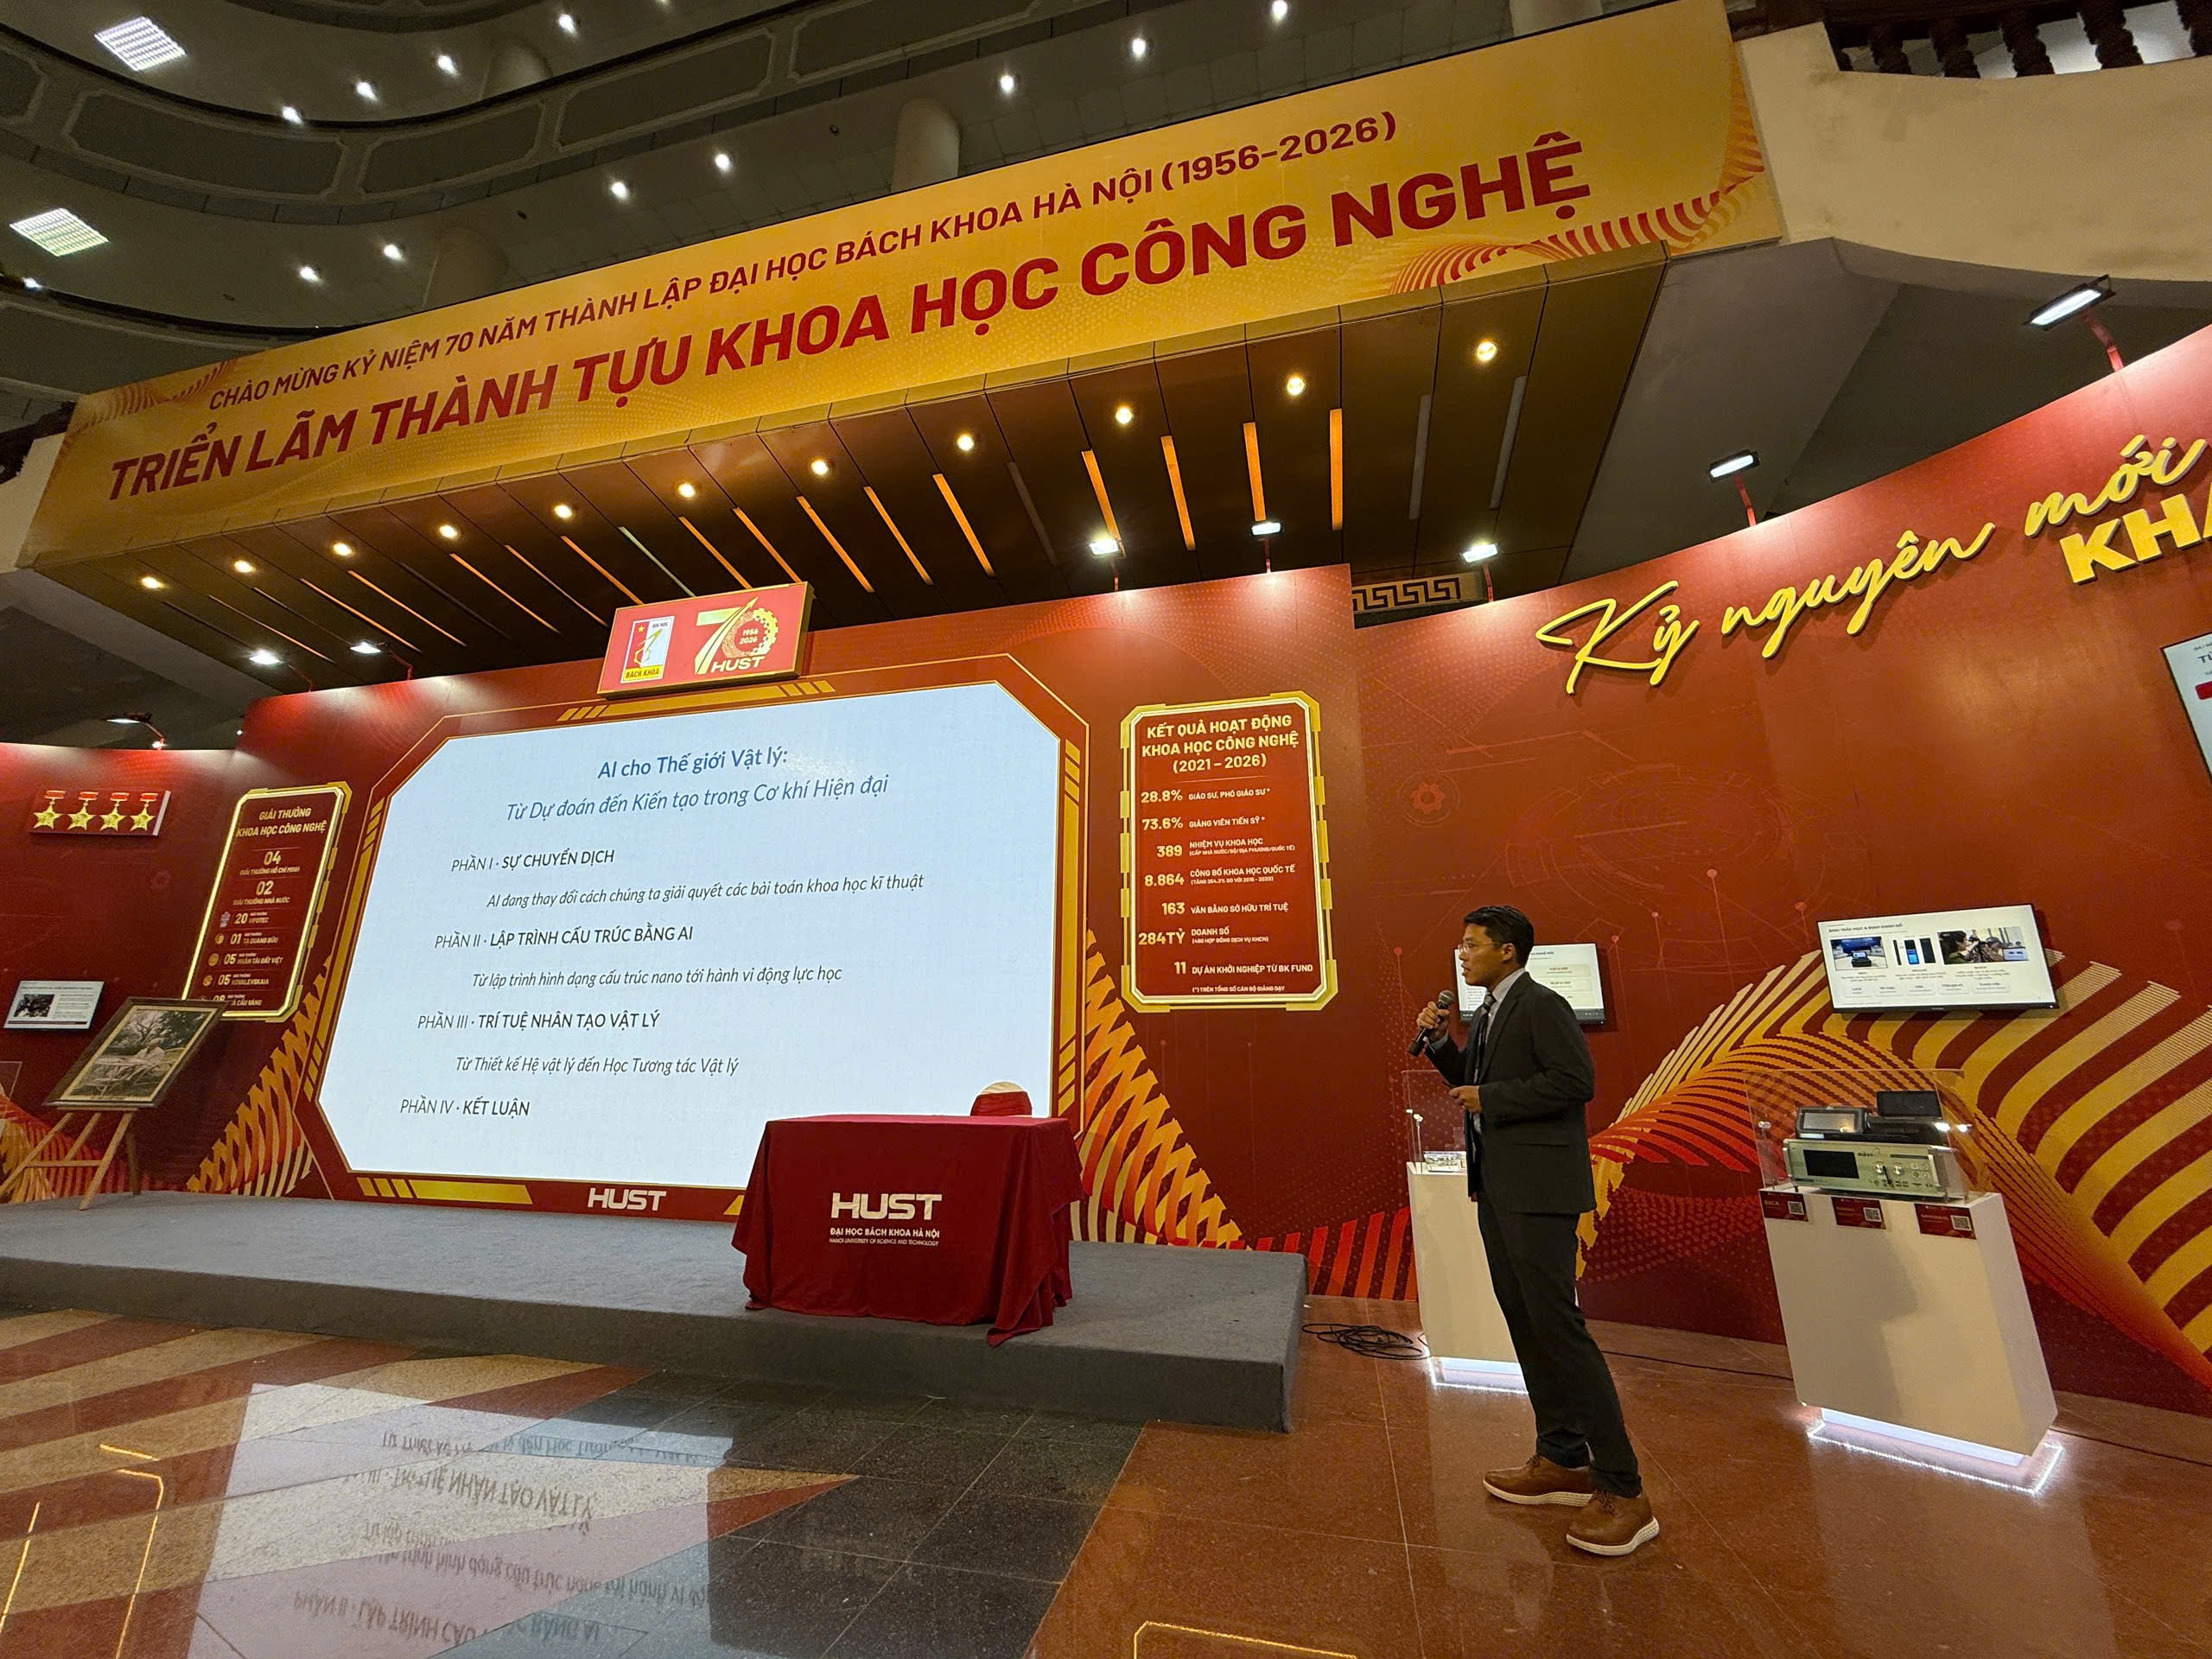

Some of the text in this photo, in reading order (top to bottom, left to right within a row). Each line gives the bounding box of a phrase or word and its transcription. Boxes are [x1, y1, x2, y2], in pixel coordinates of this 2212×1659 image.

[209, 379, 269, 410] CHÀO
[272, 364, 339, 395] MỪNG
[342, 349, 375, 379] KỶ
[379, 340, 439, 370] NIỆM
[446, 331, 474, 354] 70
[479, 315, 537, 347] NĂM
[545, 291, 637, 331] THÀNH
[643, 277, 702, 309] LẬP
[709, 263, 758, 294] ĐẠI
[766, 248, 827, 281] HỌC
[836, 225, 921, 264] BÁCH
[931, 201, 1022, 242] KHOA
[1033, 182, 1081, 218] HÀ
[1093, 168, 1152, 205] NỘI
[110, 132, 1590, 500] TRIỂN LÃM THÀNH TỰU KHOA HỌC CÔNG NGHỆ
[2060, 482, 2212, 584] KH
[1535, 435, 2208, 695] Kỷ nguyên mới
[739, 635, 758, 645] 2026
[742, 627, 759, 636] 1956
[626, 667, 660, 679] BÁCH KHOA
[710, 656, 766, 673] HUST
[1147, 714, 1292, 739] KẾT QUẢ HOẠT ĐỘNG
[1141, 731, 1299, 757] KHOA HỌC CÔNG NGHỆ
[596, 745, 787, 779] AI cho Thế giới Vật lý:
[1173, 759, 1211, 774] (2021
[1224, 753, 1267, 768] 2026)
[507, 773, 889, 822] Từ Dự đoán đến Kiến tạo trong Cơ khí Hiện đại
[1141, 789, 1182, 803] 28.8%
[1188, 791, 1206, 801] GIÁO
[259, 806, 312, 820] GIẢI THƯỞNG
[236, 820, 327, 837] KHOA HỌC CÔNG NGHỆ
[1142, 817, 1183, 830] 73.6%
[1188, 818, 1212, 829] GIẢNG
[1212, 817, 1230, 827] VIÊN
[1230, 816, 1249, 825] TIẾN
[1157, 845, 1181, 856] 389
[1189, 840, 1212, 849] NHIỆM
[1212, 839, 1224, 849] VỤ
[1247, 837, 1263, 847] HỌC
[264, 850, 282, 865] 04
[450, 847, 614, 872] PHẦN I SỰ CHUYỂN DỊCH
[1145, 874, 1184, 886] 8.864
[1189, 868, 1211, 878] CÔNG
[1211, 867, 1223, 876] BỐ
[1245, 867, 1262, 876] HỌC
[1262, 864, 1283, 874] QUỐC
[1284, 863, 1296, 873] TẾ
[256, 880, 274, 896] 02
[1162, 901, 1288, 914] 163 VĂN BẰNG SỞ HỮU TRÍ TUỆ
[234, 912, 248, 925] 20
[230, 933, 242, 945] 01
[434, 921, 693, 950] PHẦN II LẬP TRÌNH CẤU TRÚC BẰNG AI
[224, 953, 238, 965] 05
[1174, 962, 1313, 976] 11 DỰ ÁN KHỞI NGHIỆP TỪ BK FUND
[218, 974, 232, 985] 05
[417, 1008, 660, 1031] PHẦN III TRÍ TUỆ NHÂN TẠO VẬT LÝ
[399, 1094, 530, 1119] PHẦN IV KẾT LUẬN
[588, 1188, 666, 1210] HUST
[831, 1192, 942, 1219] HUST
[830, 1225, 940, 1239] ĐẠI HỌC BÁCH KHOA HÀ NỘI
